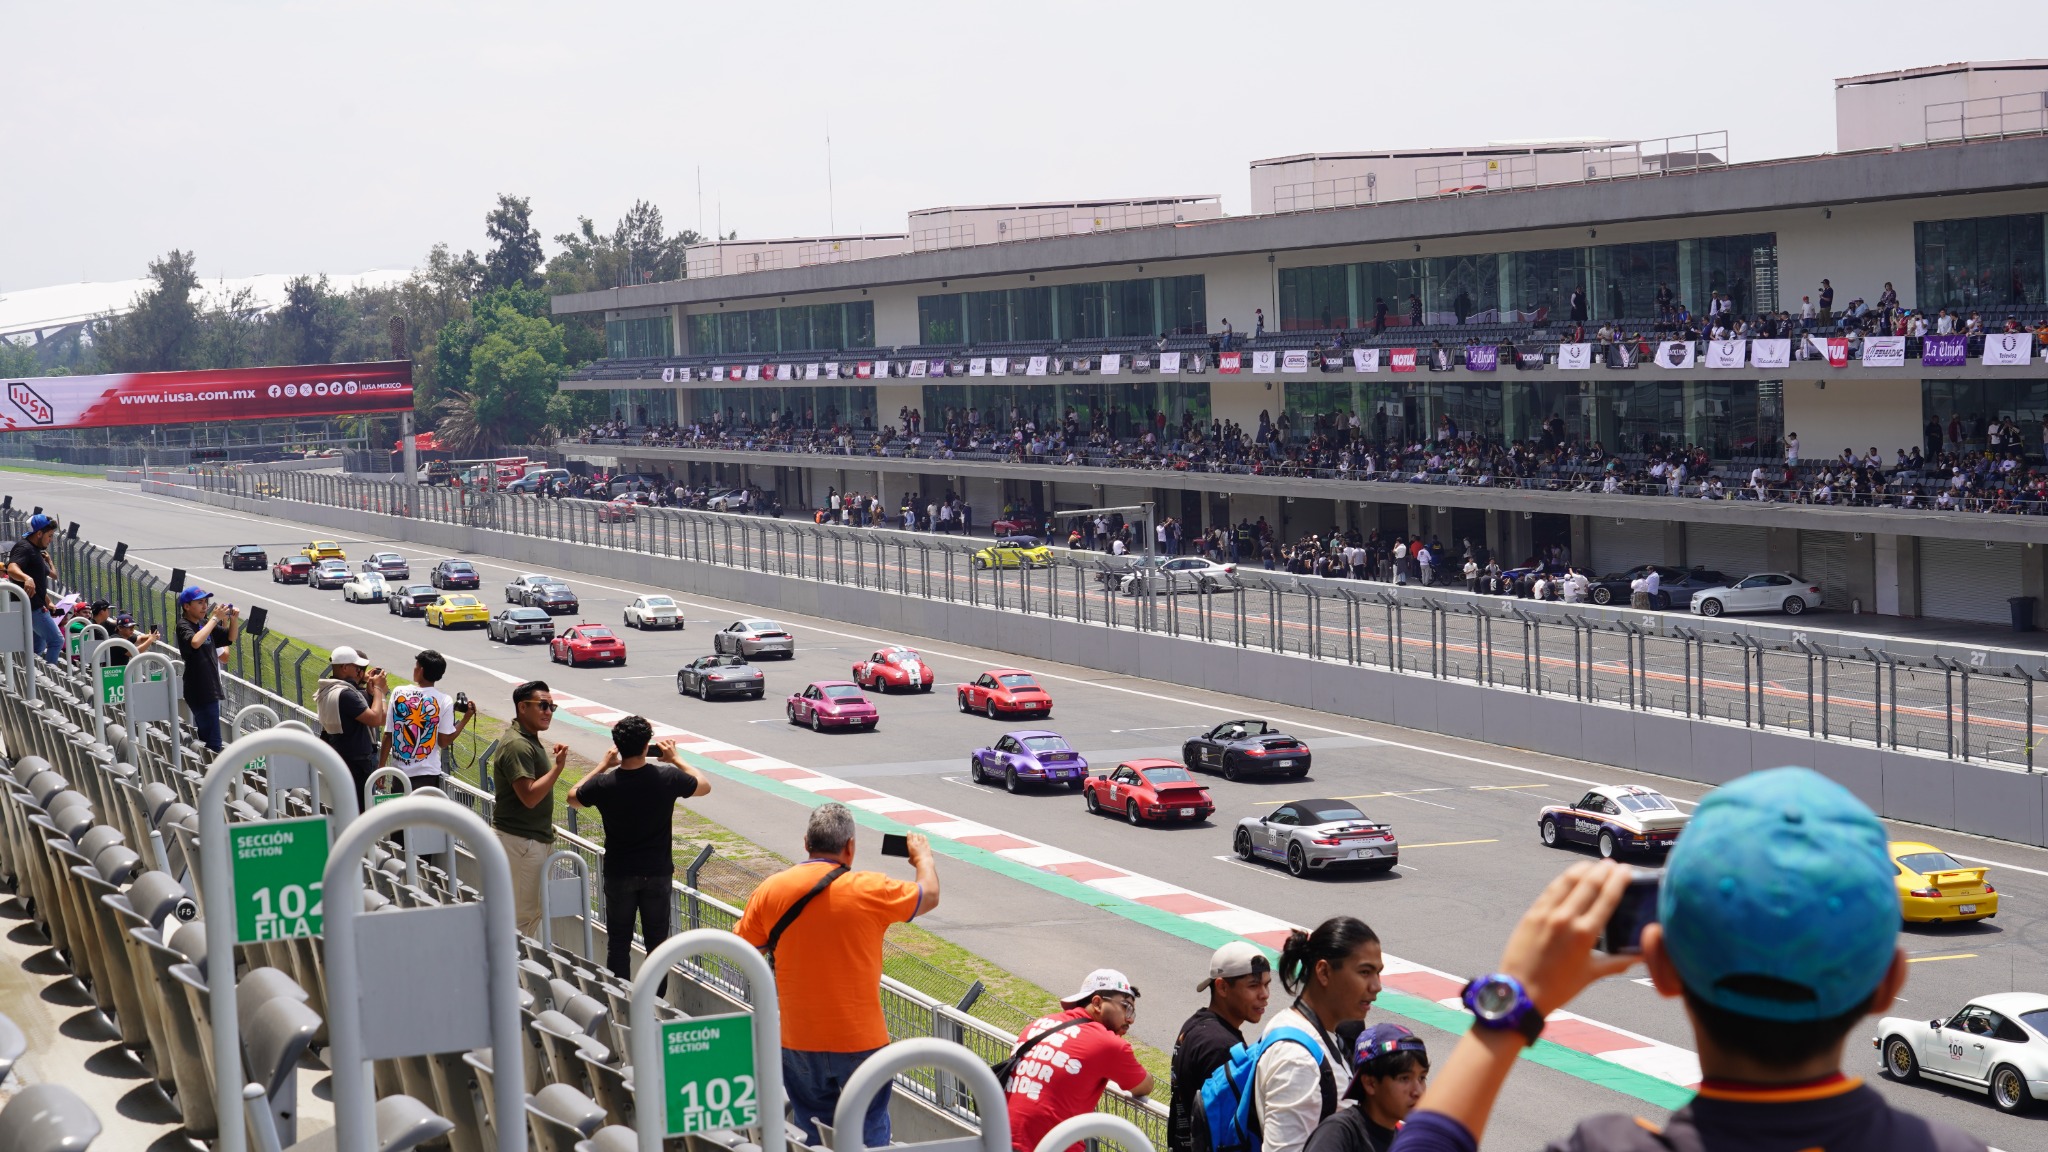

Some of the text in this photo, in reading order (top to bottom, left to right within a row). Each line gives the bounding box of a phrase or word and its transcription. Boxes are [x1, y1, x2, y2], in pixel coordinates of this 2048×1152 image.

[1925, 339, 1964, 357] La Unión
[1220, 357, 1240, 368] MOTUL
[1392, 354, 1415, 366] MOTUL
[378, 382, 402, 390] MEXICO
[13, 387, 49, 419] IUSA
[119, 389, 256, 405] www.iusa.com.mx
[1502, 601, 1512, 612] 23
[1642, 615, 1655, 627] 25
[1792, 632, 1807, 645] 26
[1971, 651, 1986, 666] 27
[108, 685, 125, 697] 10
[237, 830, 294, 848] SECCIÓN
[238, 846, 283, 859] SECTION
[181, 908, 192, 916] F5
[255, 917, 312, 941] FILA
[667, 1026, 720, 1044] SECCIÓN
[1034, 1017, 1081, 1039] YOR
[668, 1041, 710, 1055] SECTION
[1948, 1043, 1963, 1056] 100
[1015, 1059, 1054, 1083] OUR
[680, 1074, 756, 1113] 102
[683, 1106, 757, 1132] FILA 5
